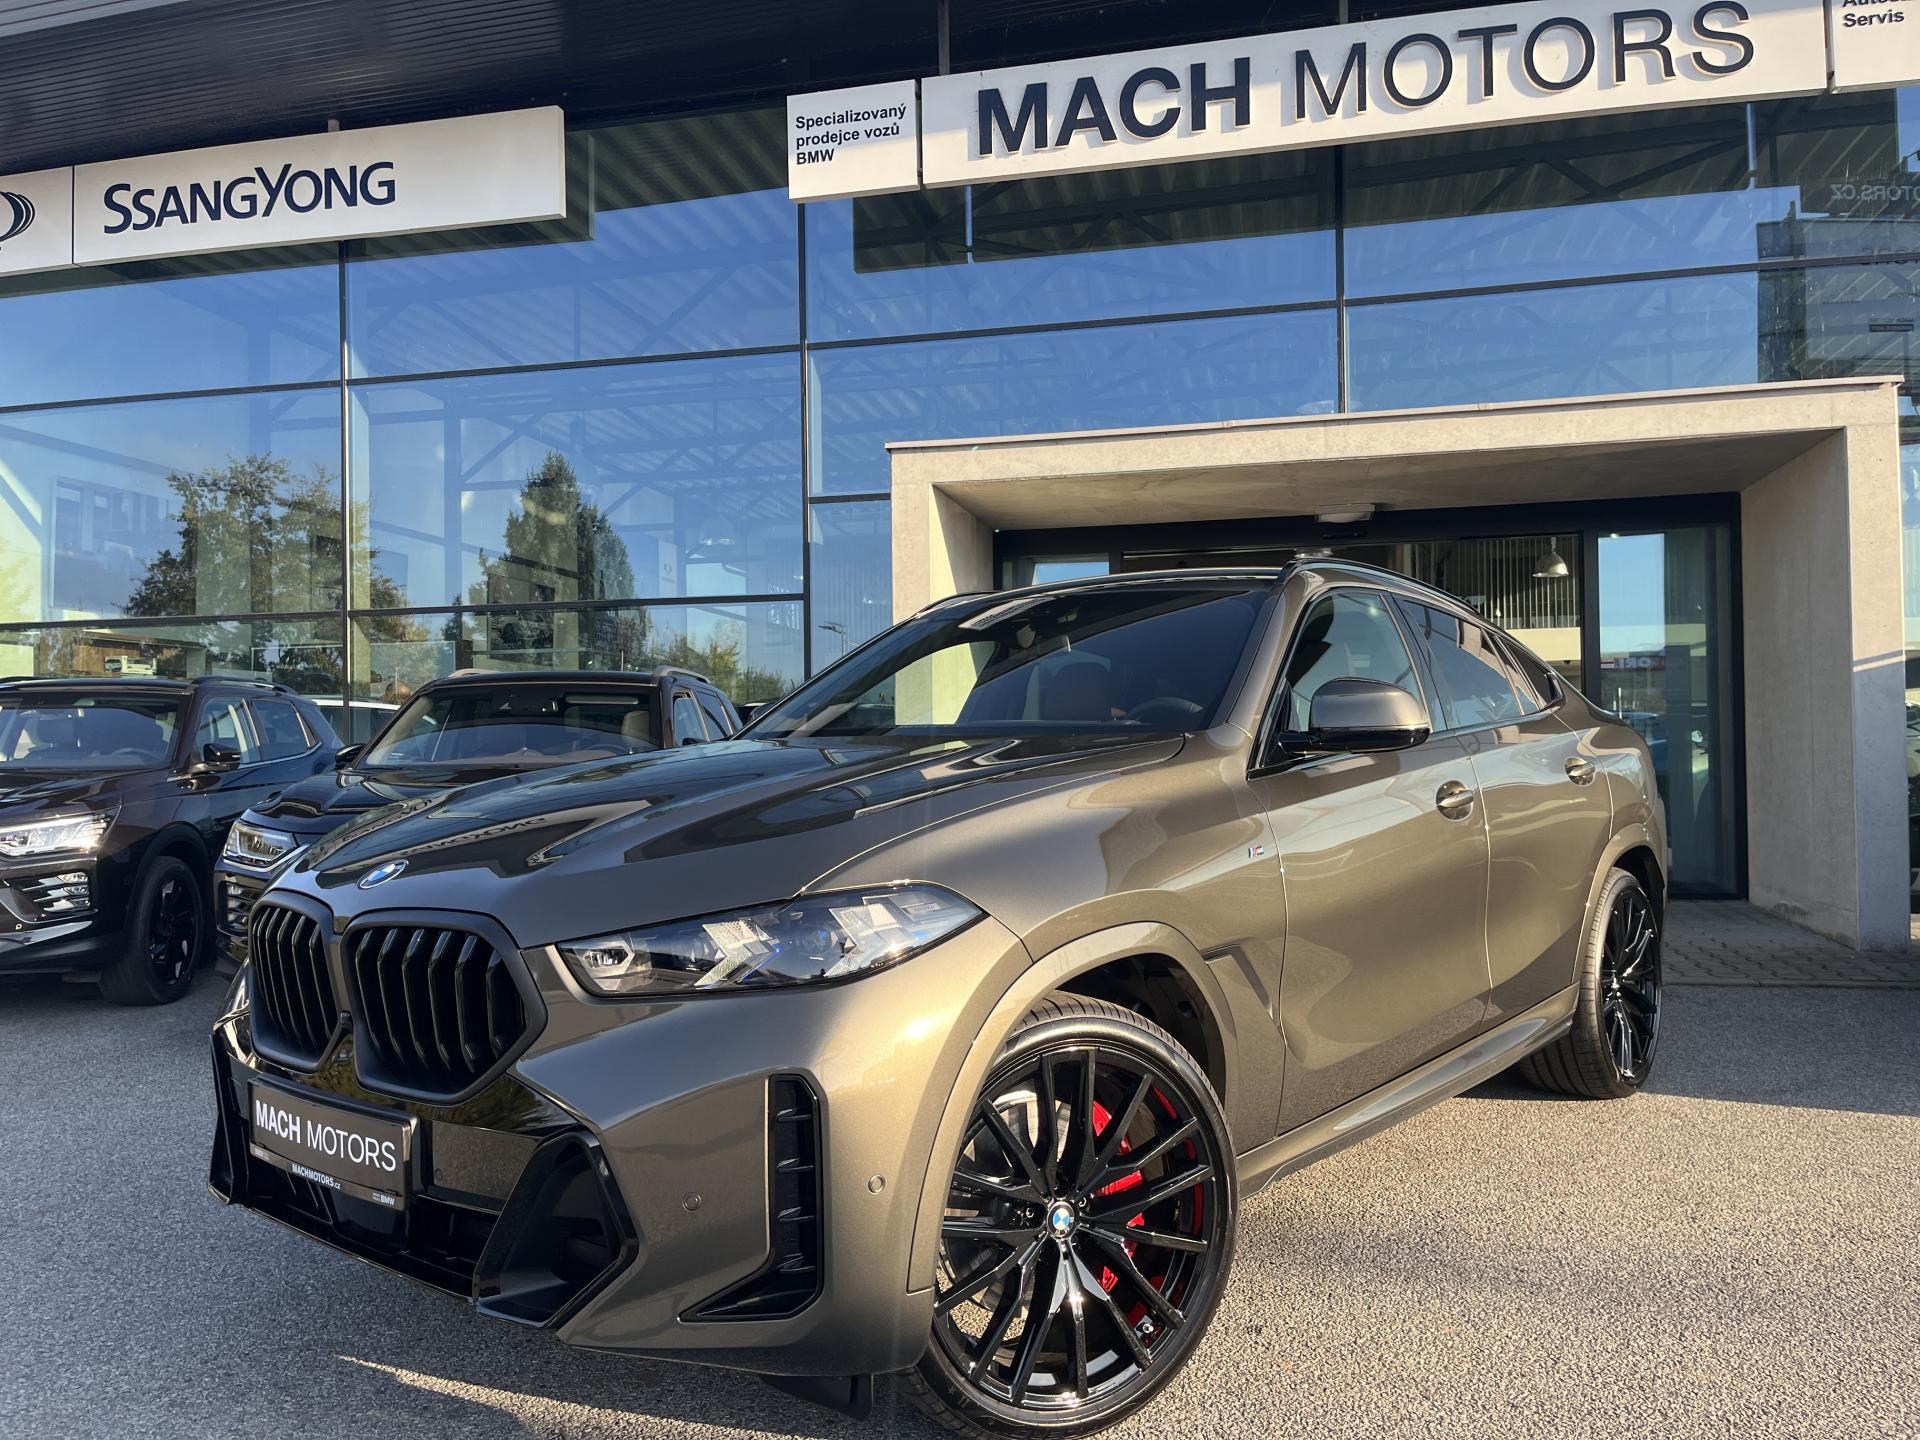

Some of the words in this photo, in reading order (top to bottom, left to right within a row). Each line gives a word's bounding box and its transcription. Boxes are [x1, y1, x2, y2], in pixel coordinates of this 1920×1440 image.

[1843, 9, 1905, 28] Servis
[978, 57, 1251, 156] MACH
[1295, 1, 1754, 119] MOTORS
[795, 103, 907, 131] Specializovaný
[796, 130, 860, 150] prodejce
[864, 122, 900, 139] vozů
[796, 148, 835, 165] BMW
[255, 1100, 301, 1144] MACH
[307, 1120, 397, 1172] MOTORS
